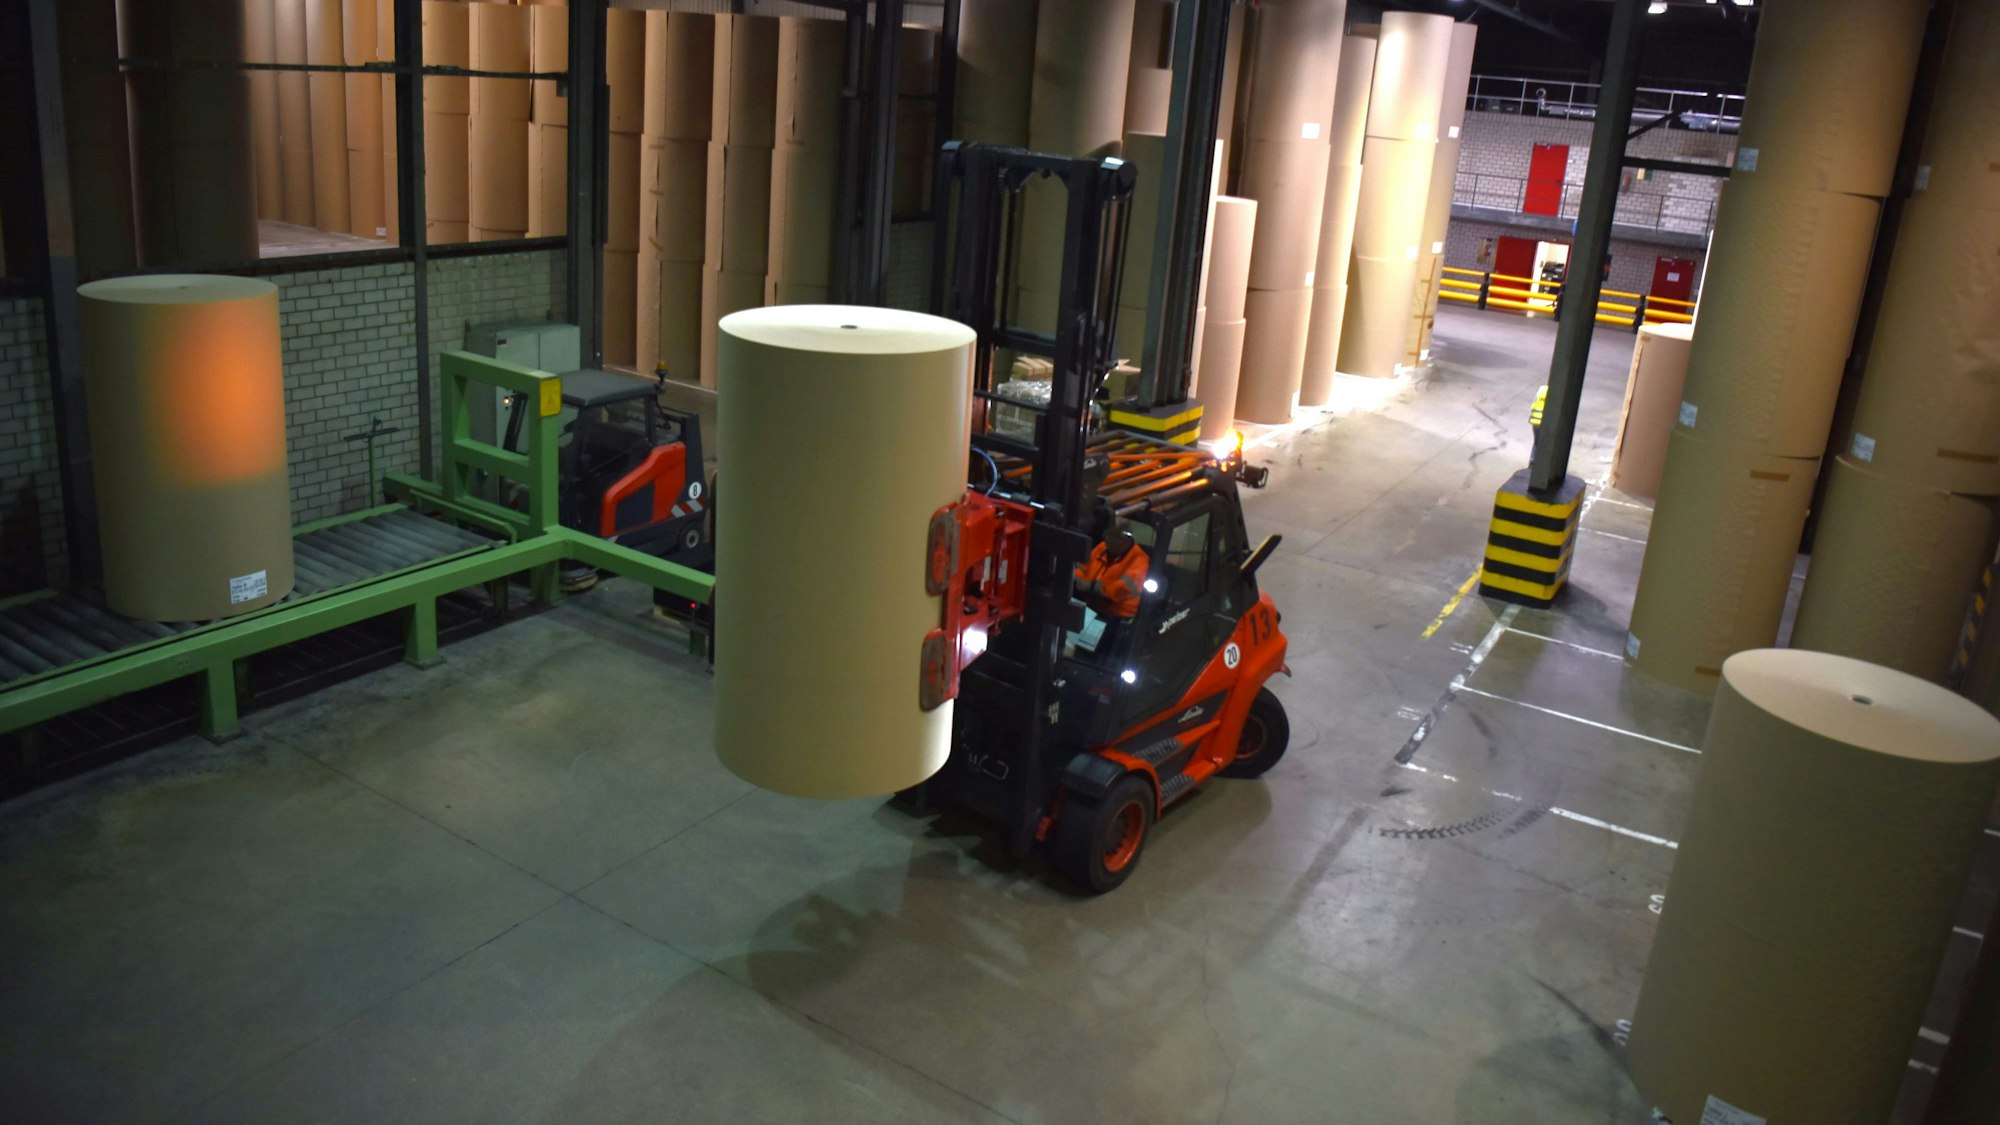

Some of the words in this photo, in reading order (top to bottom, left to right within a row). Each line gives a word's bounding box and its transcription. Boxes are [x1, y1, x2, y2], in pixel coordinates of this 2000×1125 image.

[693, 484, 698, 497] 8
[1249, 608, 1271, 645] 13
[1226, 646, 1237, 665] 20
